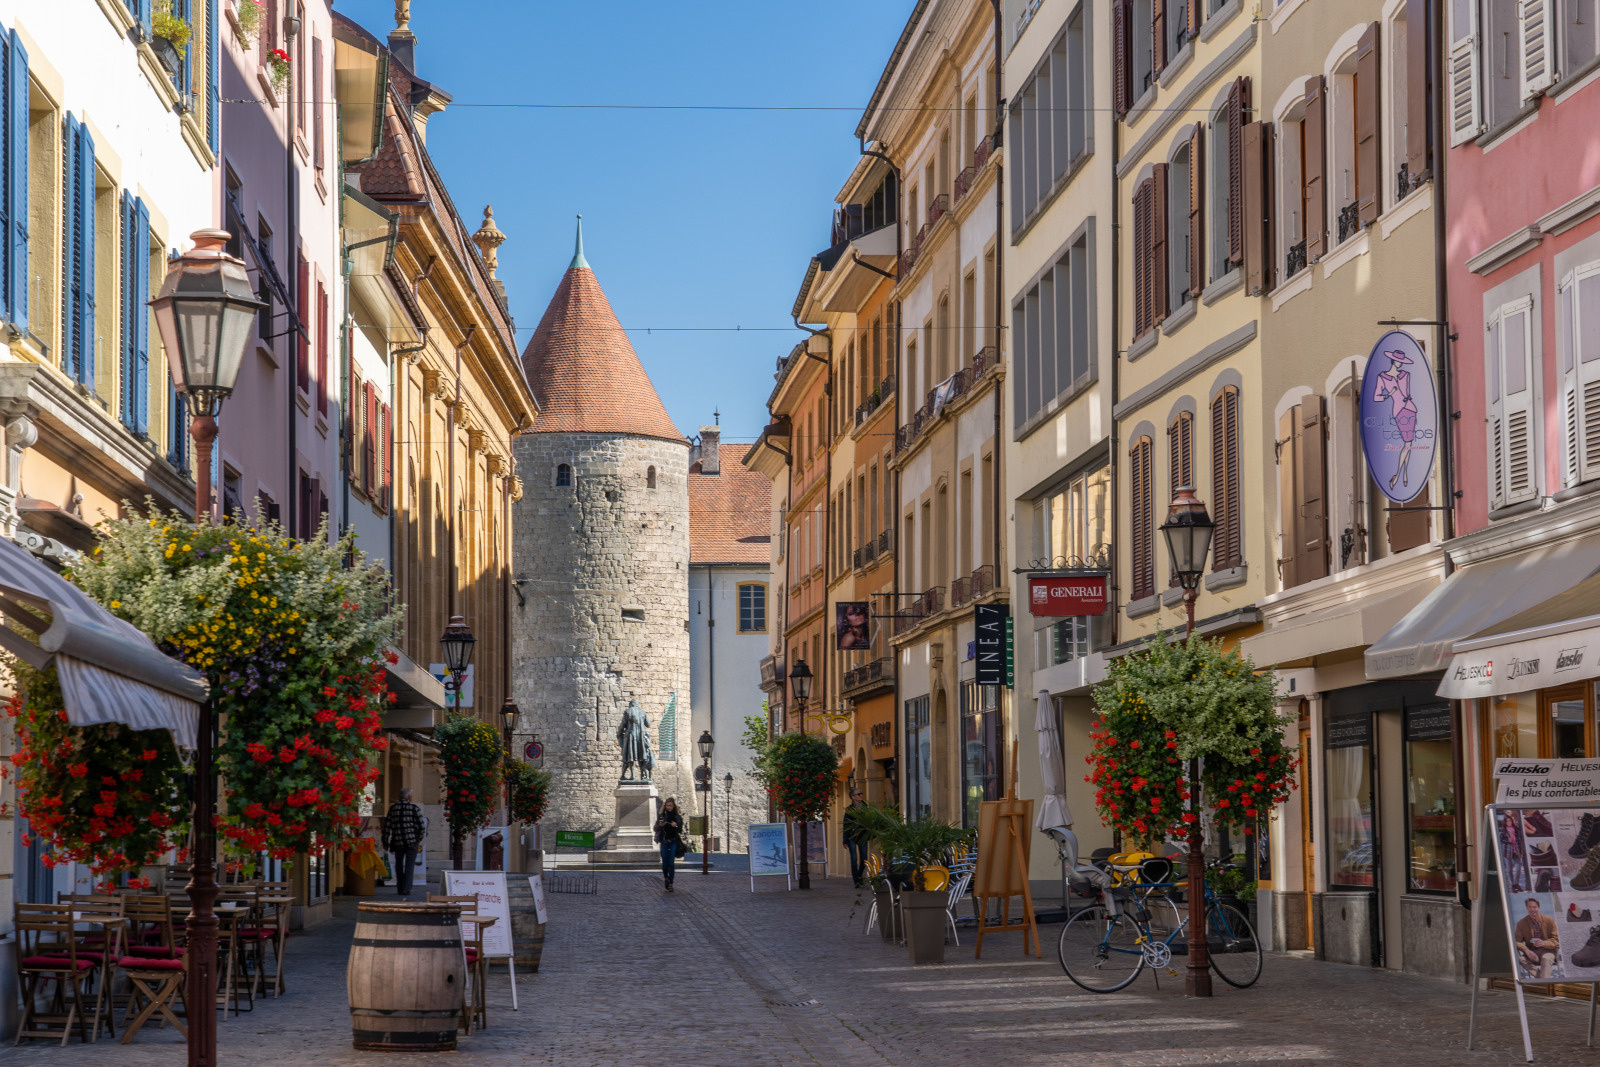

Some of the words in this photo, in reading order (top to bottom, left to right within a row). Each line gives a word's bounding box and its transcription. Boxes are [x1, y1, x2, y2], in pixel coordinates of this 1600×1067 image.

[1389, 414, 1418, 427] bon
[1383, 428, 1433, 442] temps
[1050, 586, 1103, 598] GENERALI
[979, 606, 999, 614] 7
[979, 622, 1000, 684] LINEA
[1556, 649, 1584, 669] dansko
[1453, 664, 1487, 681] HELVESKO
[1500, 763, 1550, 774] dansko
[1522, 778, 1538, 788] Les
[1540, 778, 1592, 788] chaussures
[1506, 787, 1520, 797] les
[1521, 787, 1542, 799] plus
